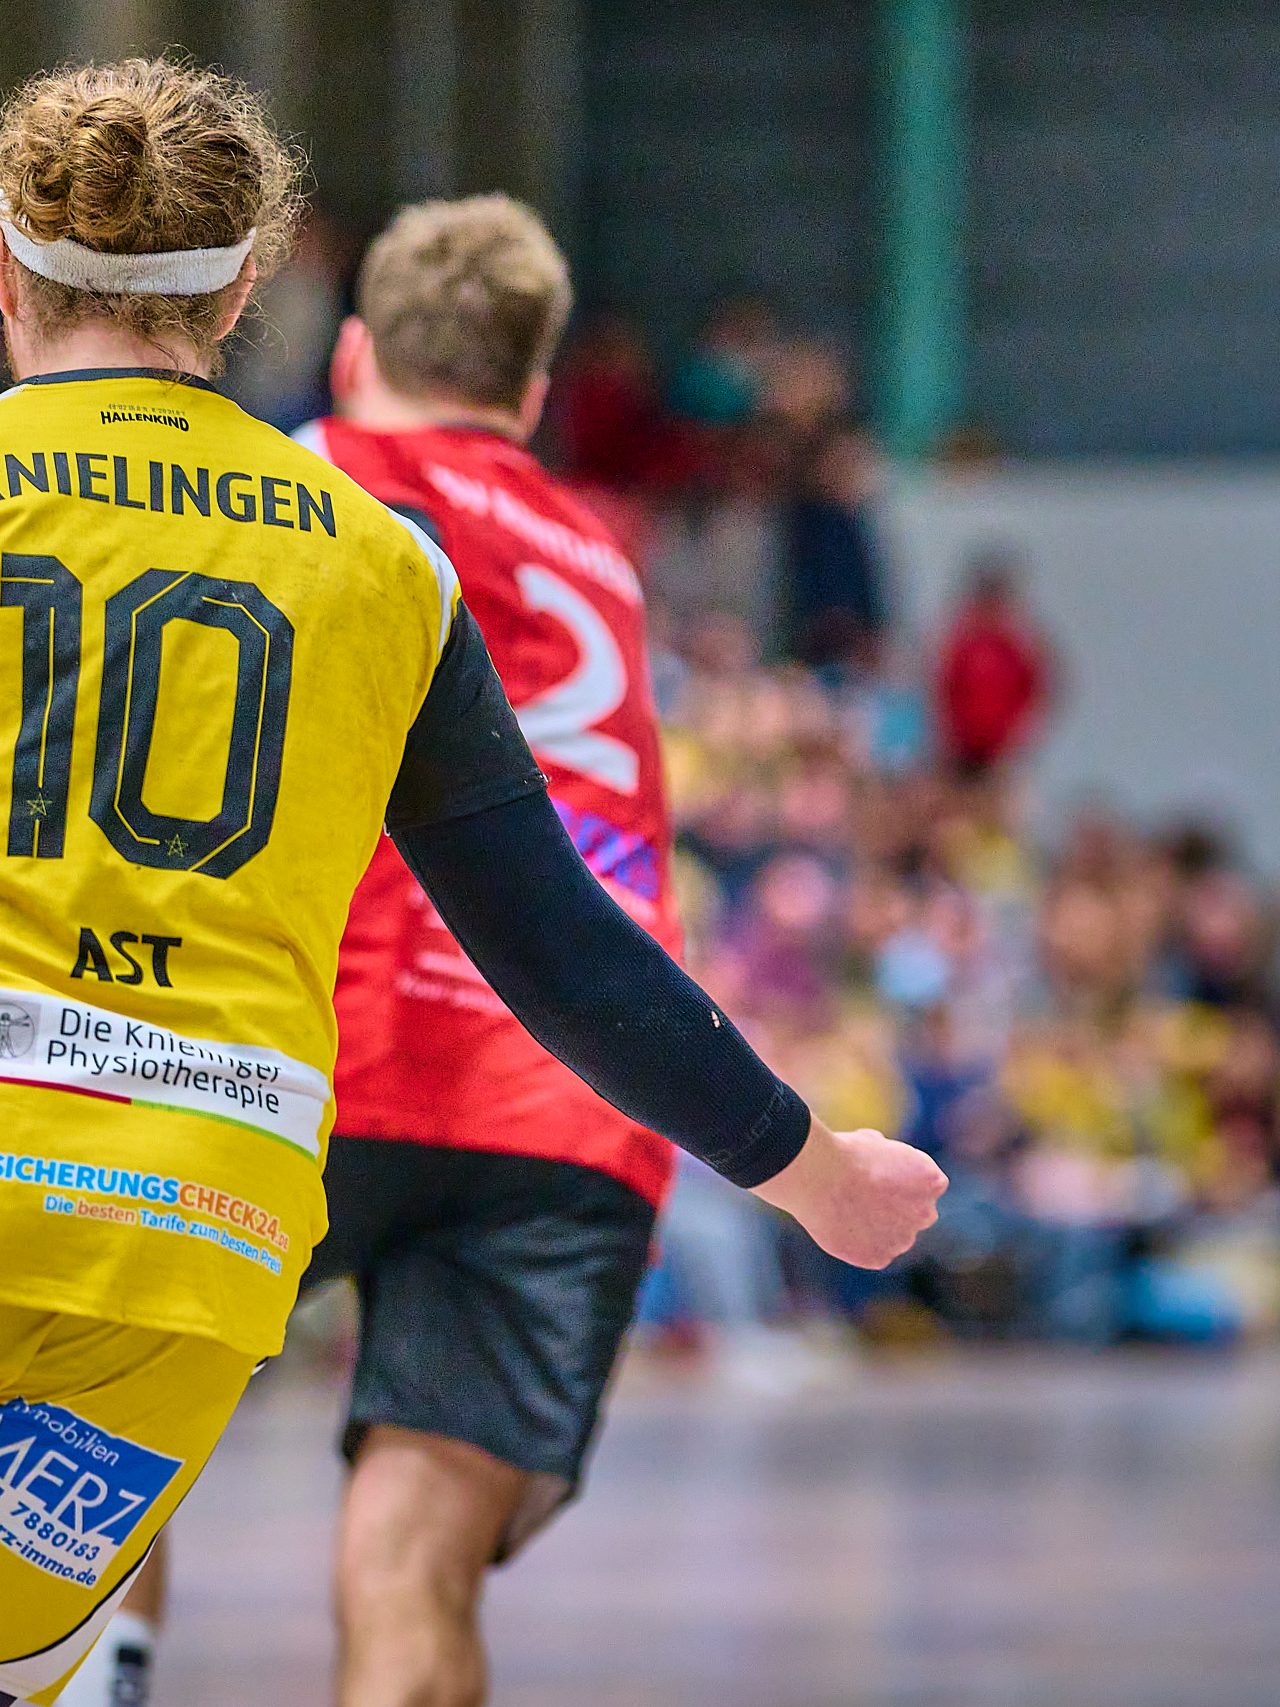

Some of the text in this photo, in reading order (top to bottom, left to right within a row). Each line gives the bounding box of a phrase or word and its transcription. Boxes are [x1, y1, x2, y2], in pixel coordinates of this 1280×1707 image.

[100, 411, 189, 432] HALLENKIND
[514, 562, 640, 797] 2
[0, 552, 296, 880] 10
[70, 927, 183, 988] AST
[59, 1007, 112, 1043] Die
[47, 1039, 280, 1114] Physiotherapie
[44, 1195, 74, 1214] Die
[78, 1200, 136, 1223] besten
[140, 1209, 187, 1233] Tarife
[189, 1221, 219, 1242] zum
[221, 1229, 259, 1261] besten
